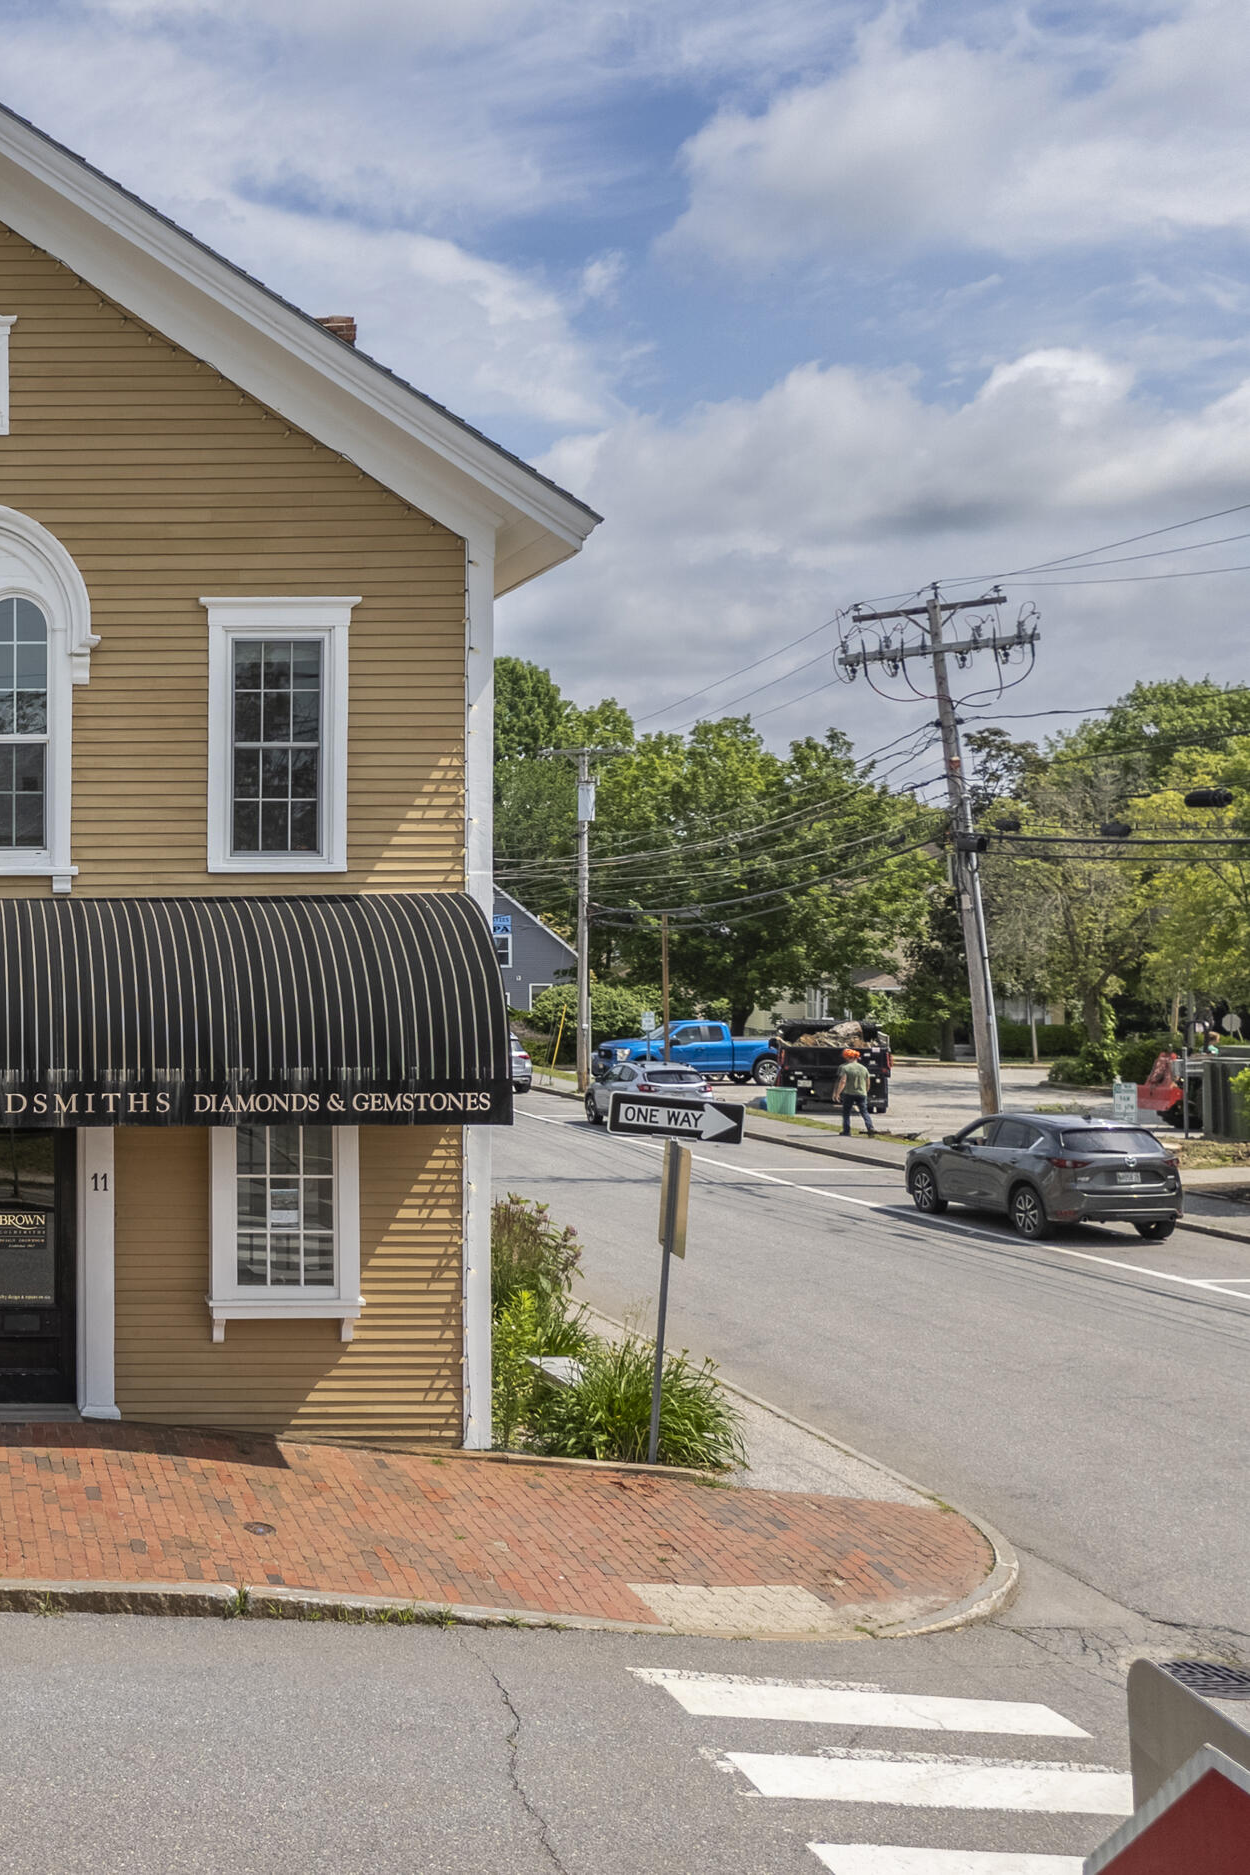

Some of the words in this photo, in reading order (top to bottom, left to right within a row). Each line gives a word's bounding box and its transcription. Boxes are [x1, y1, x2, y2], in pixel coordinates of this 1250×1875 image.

[194, 1093, 320, 1113] DIAMONDS
[326, 1093, 346, 1112] &
[352, 1092, 491, 1113] GEMSTONES
[624, 1106, 660, 1124] ONE
[667, 1110, 703, 1128] WAY
[91, 1172, 109, 1191] 11
